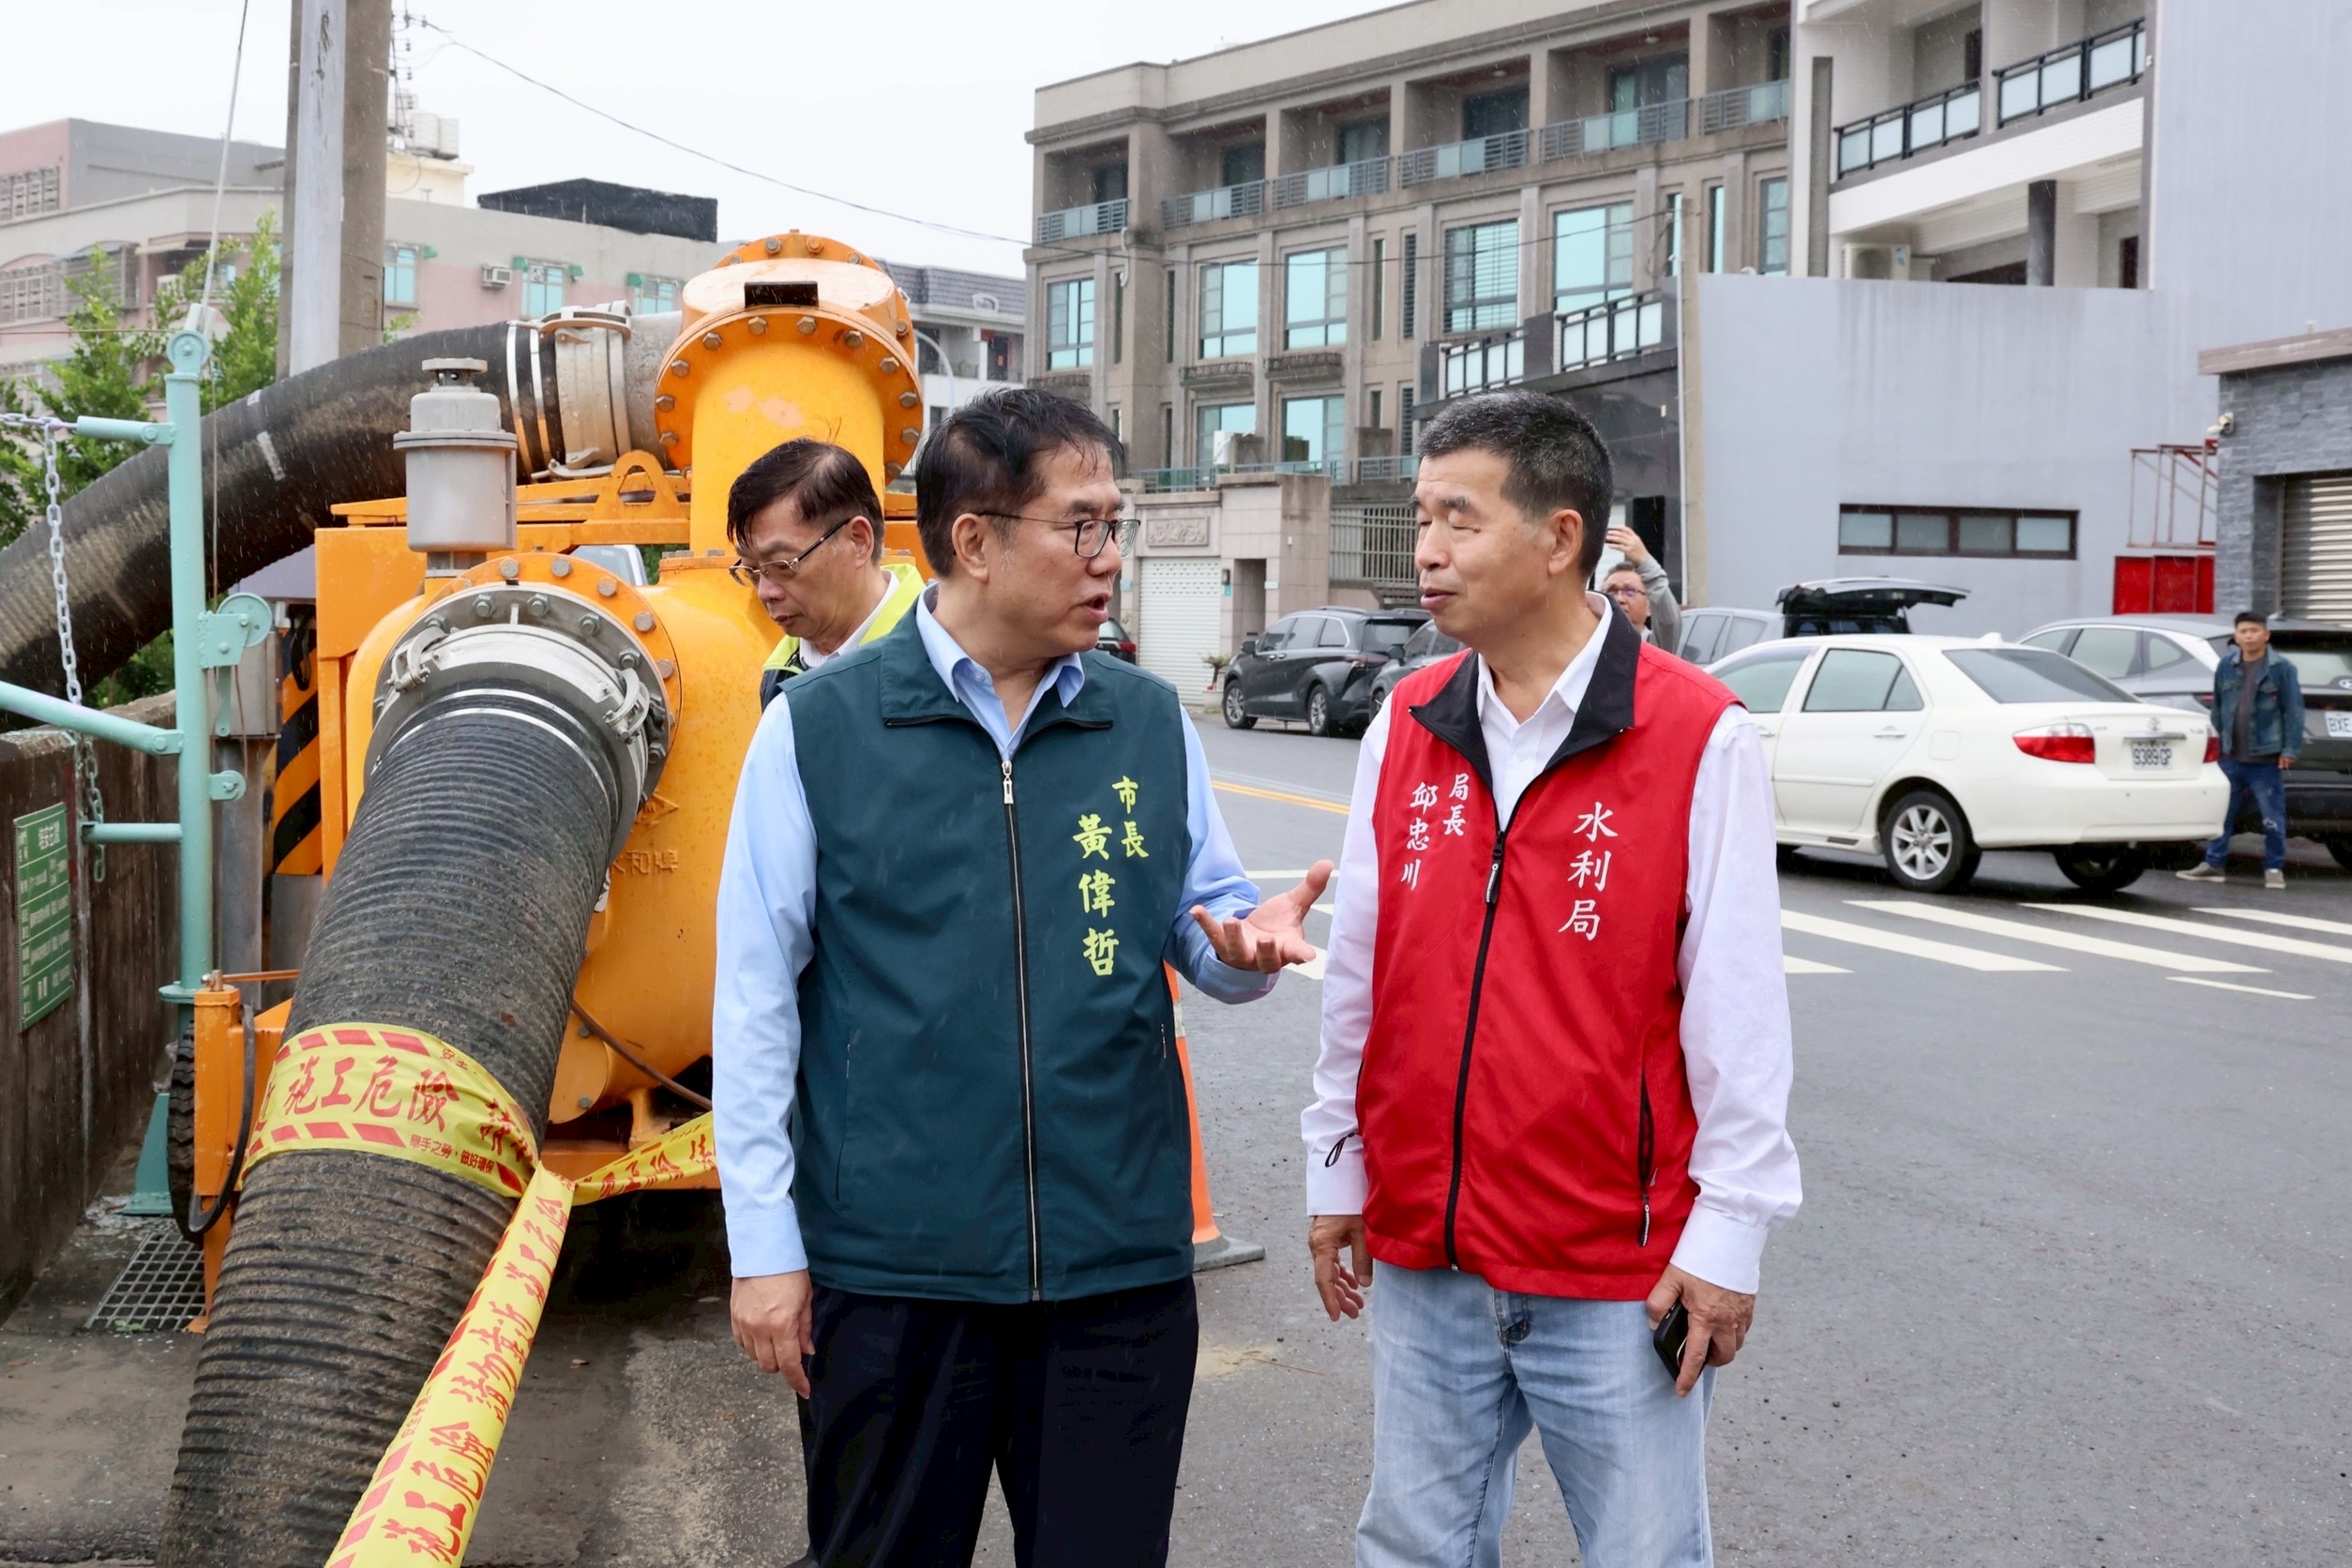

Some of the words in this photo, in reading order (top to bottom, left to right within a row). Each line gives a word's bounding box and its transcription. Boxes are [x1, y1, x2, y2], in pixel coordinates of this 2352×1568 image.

[1111, 776, 1150, 858] 市長
[1400, 781, 1440, 891] 邱忠川
[1442, 773, 1470, 837] 局長
[1073, 813, 1120, 976] 黃偉哲
[1558, 802, 1619, 942] 水利局
[283, 1055, 460, 1134] 施工危險
[381, 1422, 495, 1565] 施工危險
